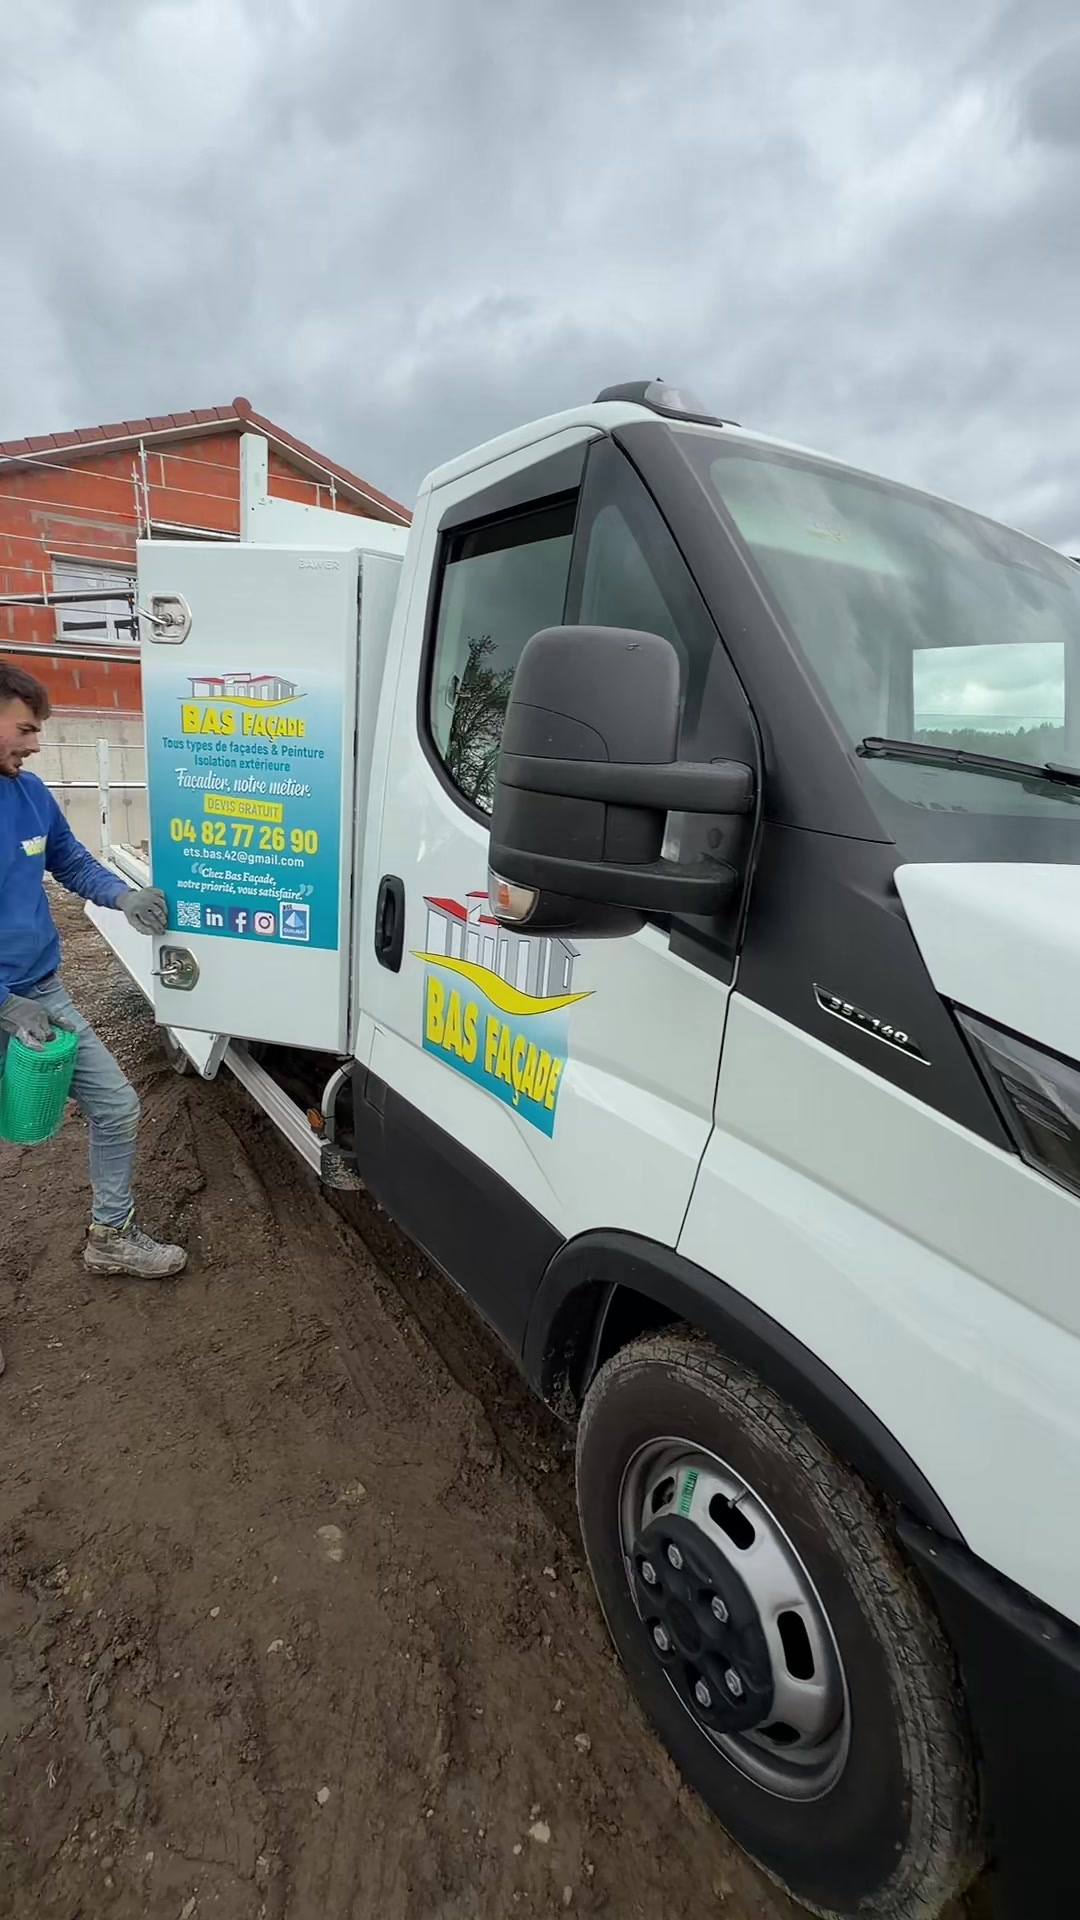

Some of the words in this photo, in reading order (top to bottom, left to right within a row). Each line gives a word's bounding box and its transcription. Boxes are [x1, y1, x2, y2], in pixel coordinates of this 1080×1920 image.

[181, 704, 236, 735] BAS
[242, 712, 305, 742] FAÇADE
[162, 737, 185, 749] Tous
[186, 740, 213, 754] types
[215, 740, 228, 752] de
[229, 741, 268, 756] façades
[271, 745, 278, 756] &
[282, 745, 325, 759] Peinture
[195, 755, 237, 768] Isolation
[239, 757, 291, 772] extérieure
[175, 768, 231, 793] Façadier,
[234, 775, 266, 793] notre
[208, 798, 236, 813] DEVIS
[239, 802, 279, 818] GRATUIT
[170, 818, 196, 843] 04
[201, 820, 227, 846] 82
[231, 823, 254, 848] 77
[259, 826, 285, 852] 26
[290, 829, 318, 854] 90
[183, 847, 304, 867] ets.bas.42@gmail.com
[177, 879, 200, 890] notre
[237, 885, 258, 896] vous
[225, 869, 242, 881] Bas
[243, 872, 277, 886] Façade,
[425, 974, 479, 1064] BAS
[484, 1013, 563, 1111] FAÇADE
